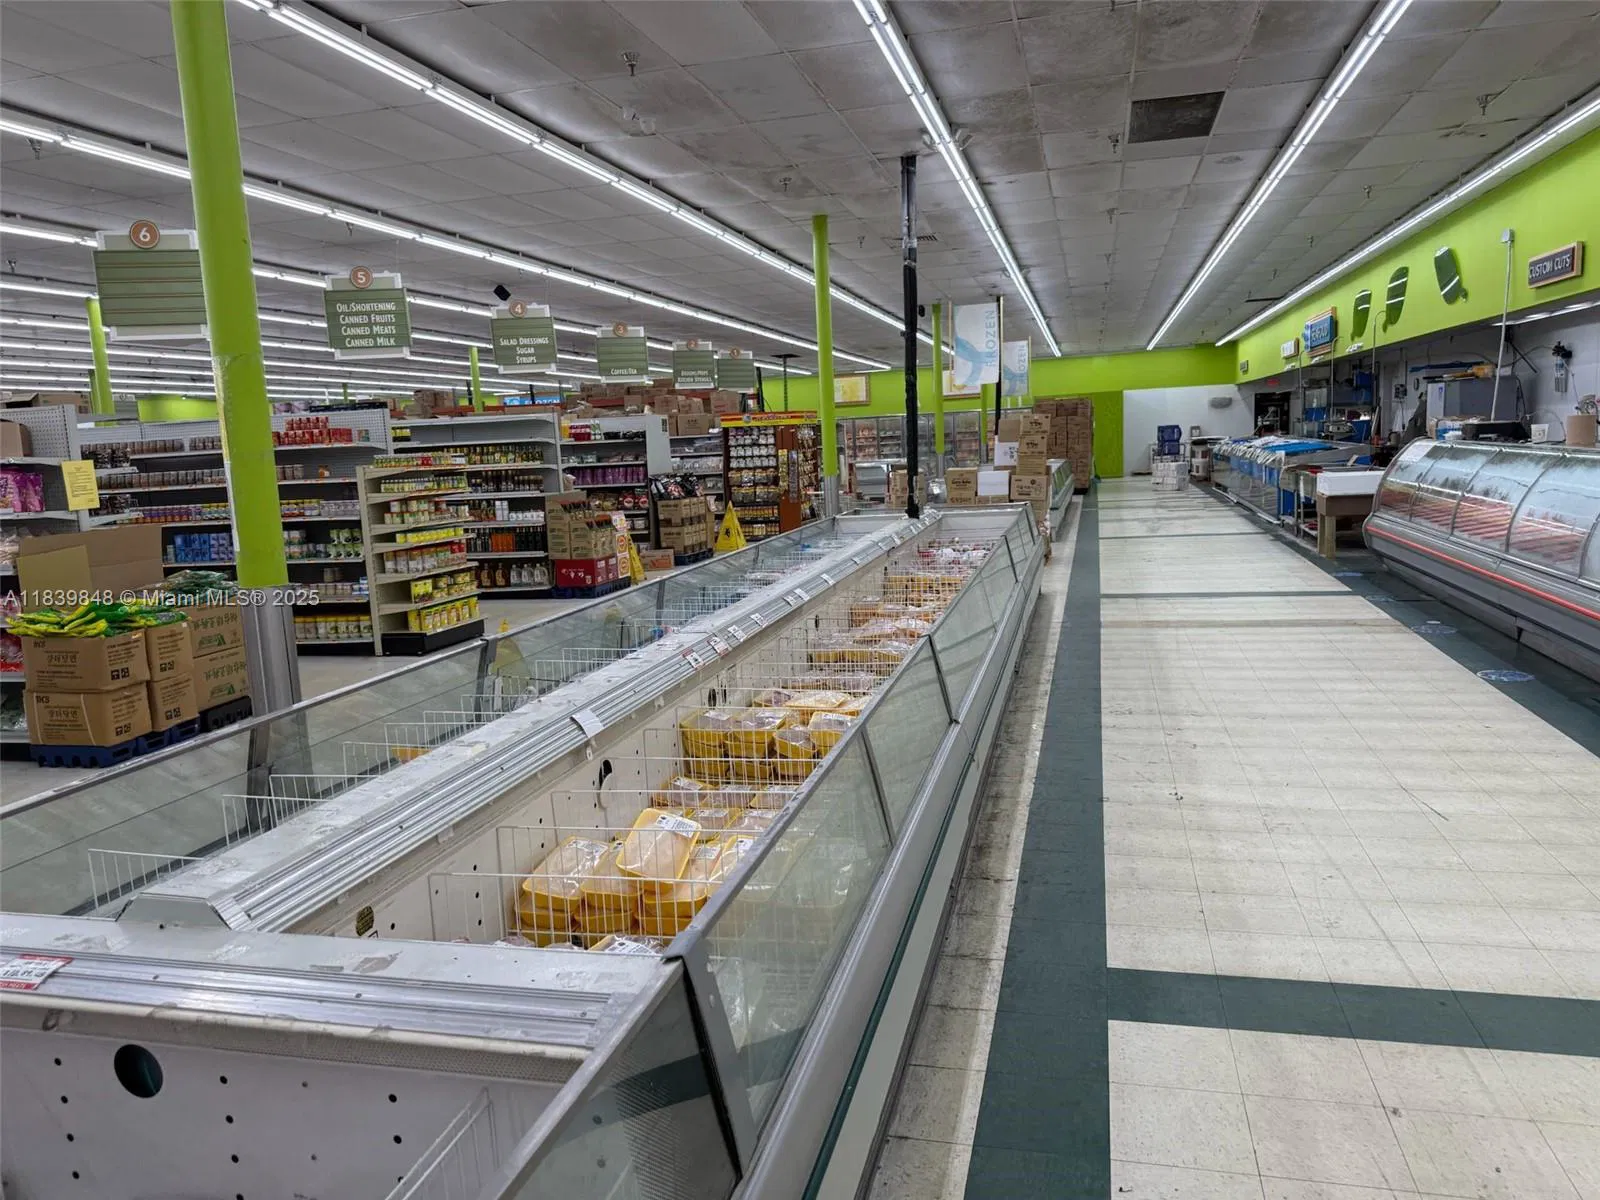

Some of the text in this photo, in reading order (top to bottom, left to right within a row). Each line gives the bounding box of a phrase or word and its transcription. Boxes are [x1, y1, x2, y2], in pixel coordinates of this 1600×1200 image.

[139, 227, 151, 242] 6
[1528, 254, 1571, 279] CUSTOM CUTS
[357, 271, 366, 283] 5
[515, 304, 522, 313] 4
[340, 313, 396, 324] CANNED FRUITS
[341, 325, 396, 335] CANNED MEATS
[617, 325, 624, 334] 3
[345, 336, 396, 347] CANNED MILK
[984, 309, 996, 368] FROZEN
